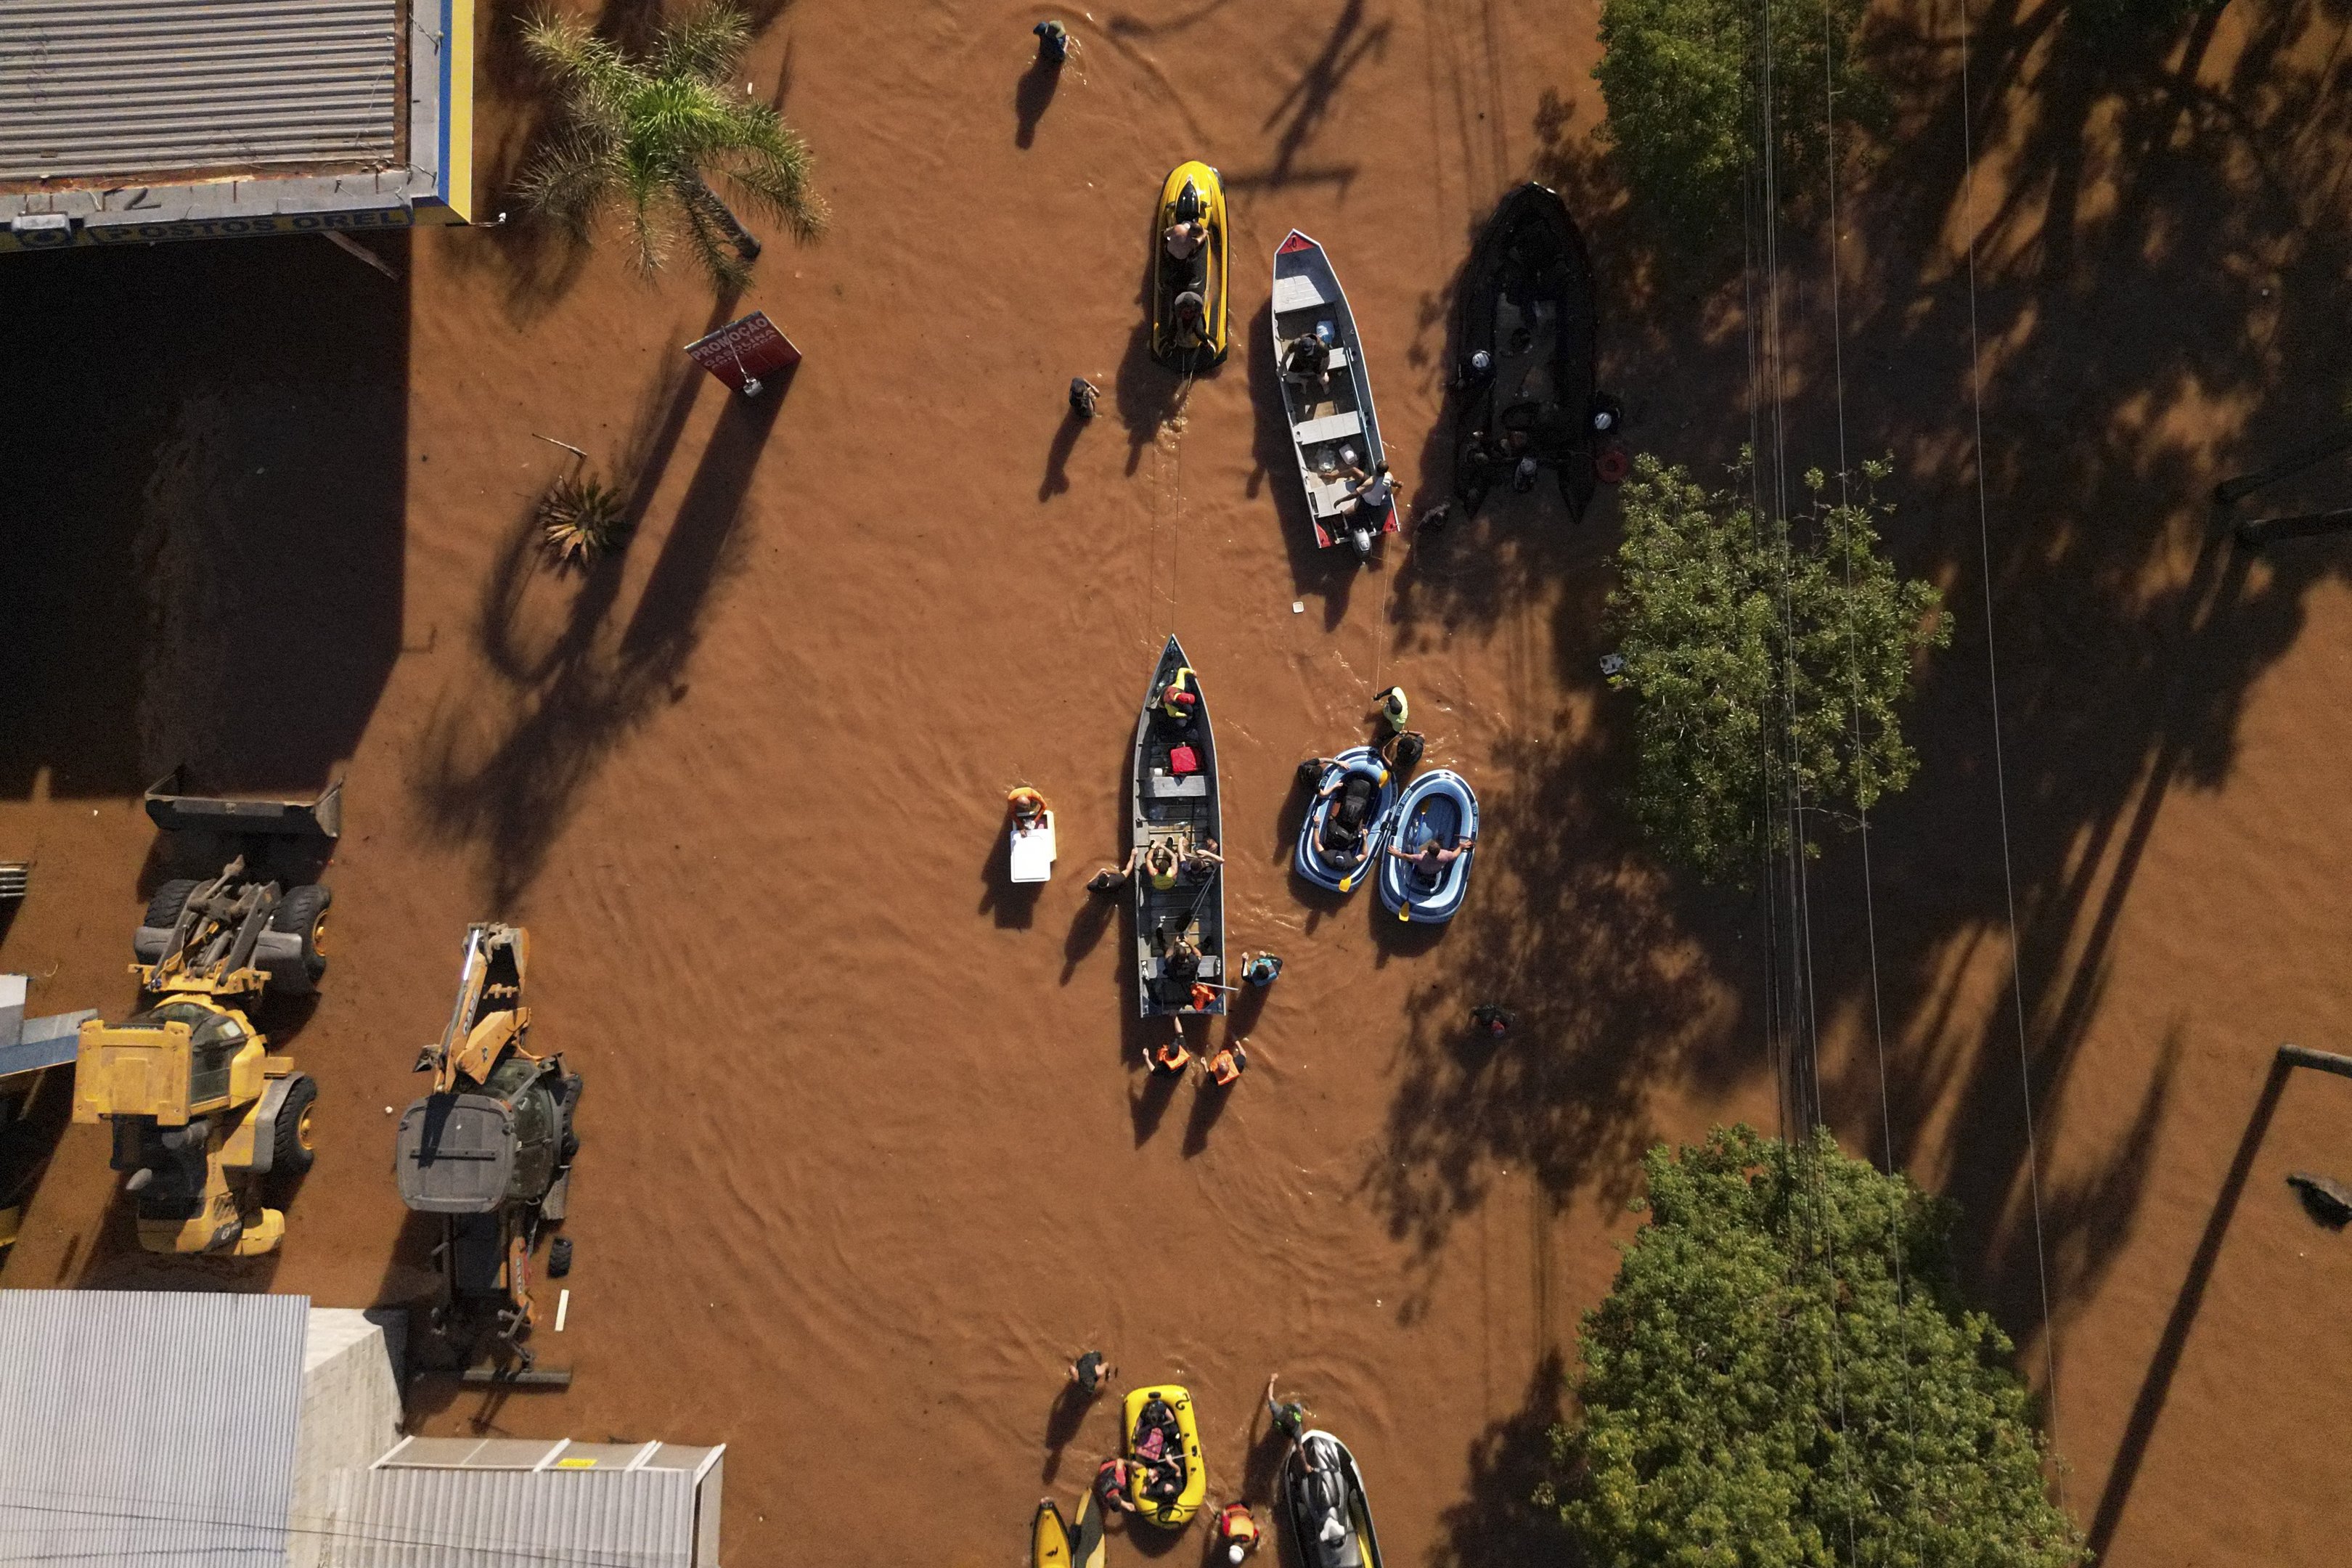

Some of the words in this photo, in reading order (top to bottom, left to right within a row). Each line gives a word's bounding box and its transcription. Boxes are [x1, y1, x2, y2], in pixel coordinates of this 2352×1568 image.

[107, 219, 275, 240] POSTOS
[293, 212, 407, 230] OREL
[690, 318, 768, 361] PROMOÇÃO
[704, 329, 775, 367] GASOLINA
